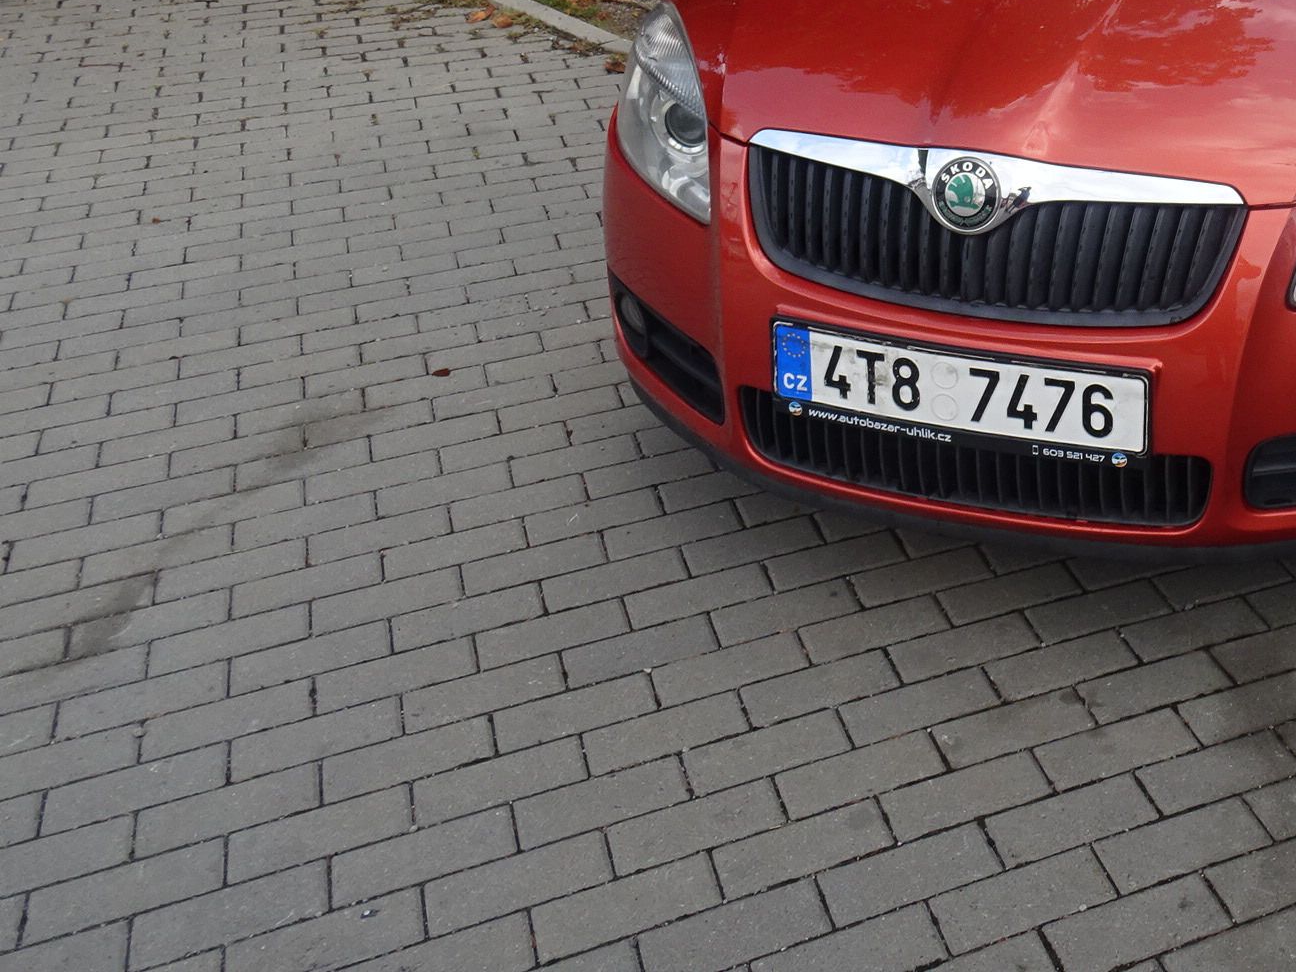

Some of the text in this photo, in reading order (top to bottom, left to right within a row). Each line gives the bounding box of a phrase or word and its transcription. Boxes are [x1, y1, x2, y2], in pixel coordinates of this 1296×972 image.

[783, 372, 808, 393] CZ
[823, 344, 1115, 438] 4T8 7476
[808, 408, 952, 442] www.autobazar-uhlik.cz
[1042, 448, 1106, 462] 603 521 427
